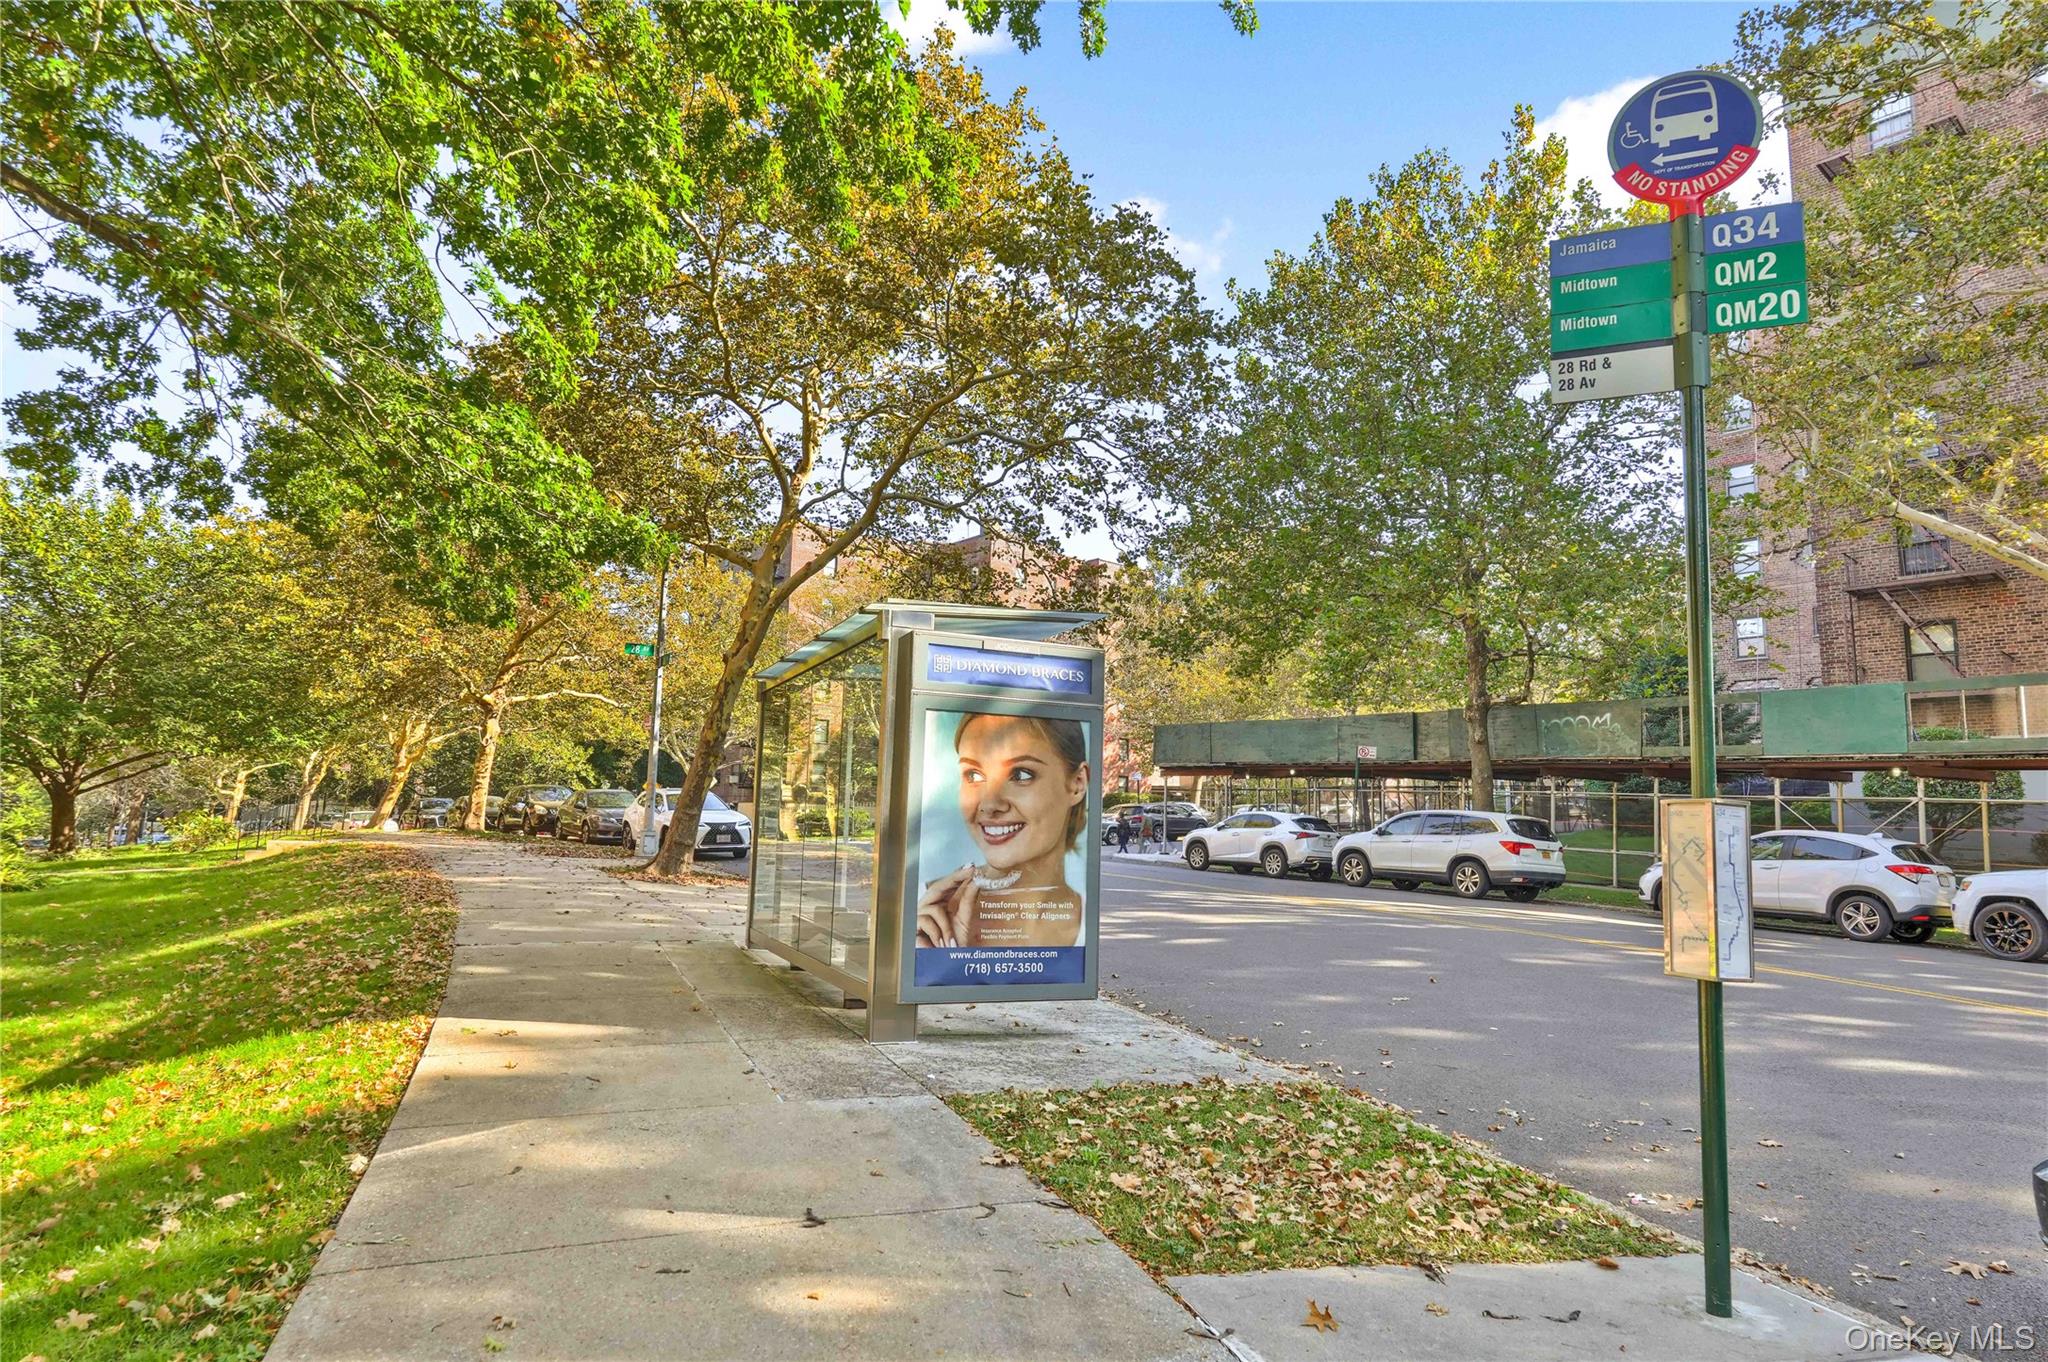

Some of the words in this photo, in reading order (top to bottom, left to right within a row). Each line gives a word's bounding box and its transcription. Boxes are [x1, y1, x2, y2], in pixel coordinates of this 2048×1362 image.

[1627, 170, 1654, 191] NO
[1655, 150, 1750, 197] STANDING
[1674, 160, 1716, 172] TRANSPORTATION
[1712, 211, 1780, 247] Q34
[1560, 238, 1617, 257] Jamaica
[1714, 251, 1777, 287] QM2
[1560, 276, 1618, 295] Midtown
[1715, 289, 1801, 327] QM20
[1560, 314, 1618, 332] Midtown
[1558, 361, 1574, 375] 28
[1579, 358, 1597, 372] Rd
[1602, 356, 1612, 370] &
[1558, 378, 1575, 392] 28
[1579, 376, 1597, 390] Av
[631, 644, 641, 654] 28
[956, 659, 1028, 677] DIAMOND
[1031, 668, 1085, 683] BRACES
[980, 901, 1018, 909] Transform
[1019, 902, 1035, 911] your
[1036, 901, 1057, 909] Smile
[1058, 901, 1074, 909] with
[1020, 912, 1040, 920] Clear
[1040, 912, 1071, 921] Aligners
[949, 949, 1058, 960] www.diamondbraces.com
[964, 963, 991, 976] (718)
[994, 962, 1044, 974] 657-3500
